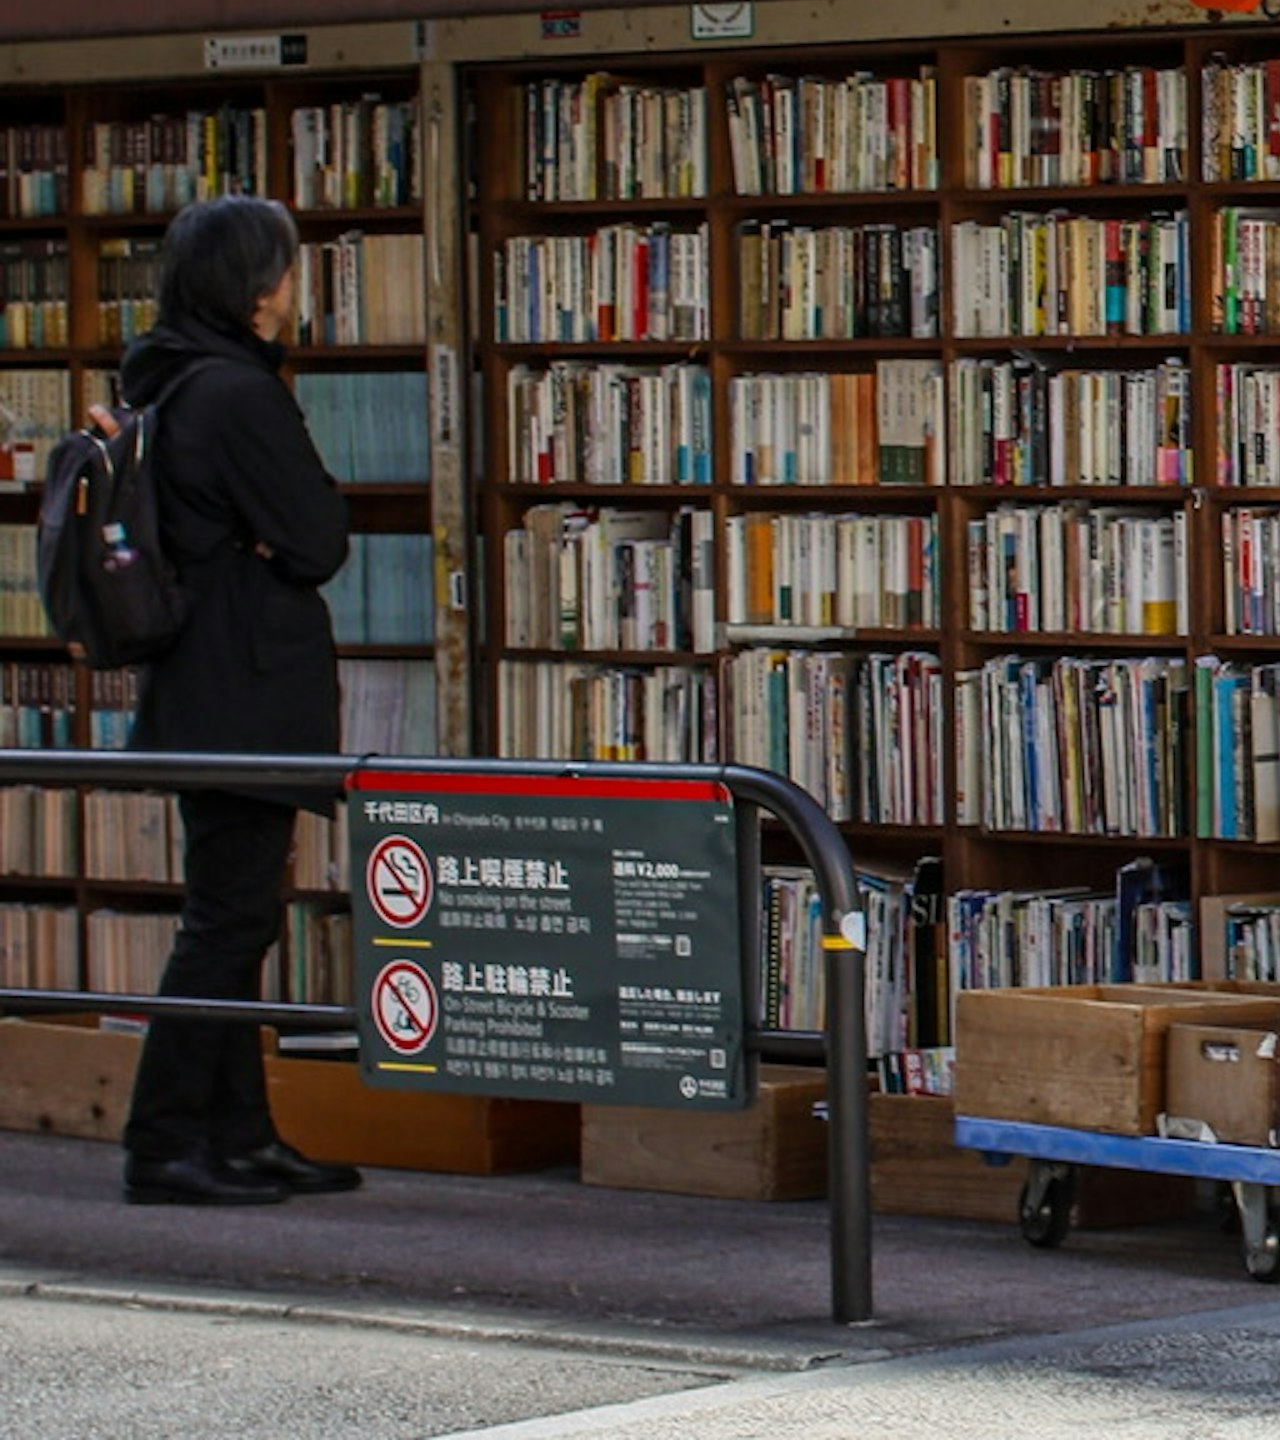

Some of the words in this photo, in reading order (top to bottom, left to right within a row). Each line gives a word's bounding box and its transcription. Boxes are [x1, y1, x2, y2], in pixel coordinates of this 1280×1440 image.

[363, 801, 439, 824] 千代田区内
[436, 855, 569, 890] 路上喫煙禁止
[457, 893, 502, 912] smoking
[520, 893, 537, 910] the
[442, 961, 573, 998] 路上駐輪禁止
[496, 999, 534, 1020] Bicycle
[549, 1001, 590, 1021] Scooter
[444, 1016, 485, 1037] Parking
